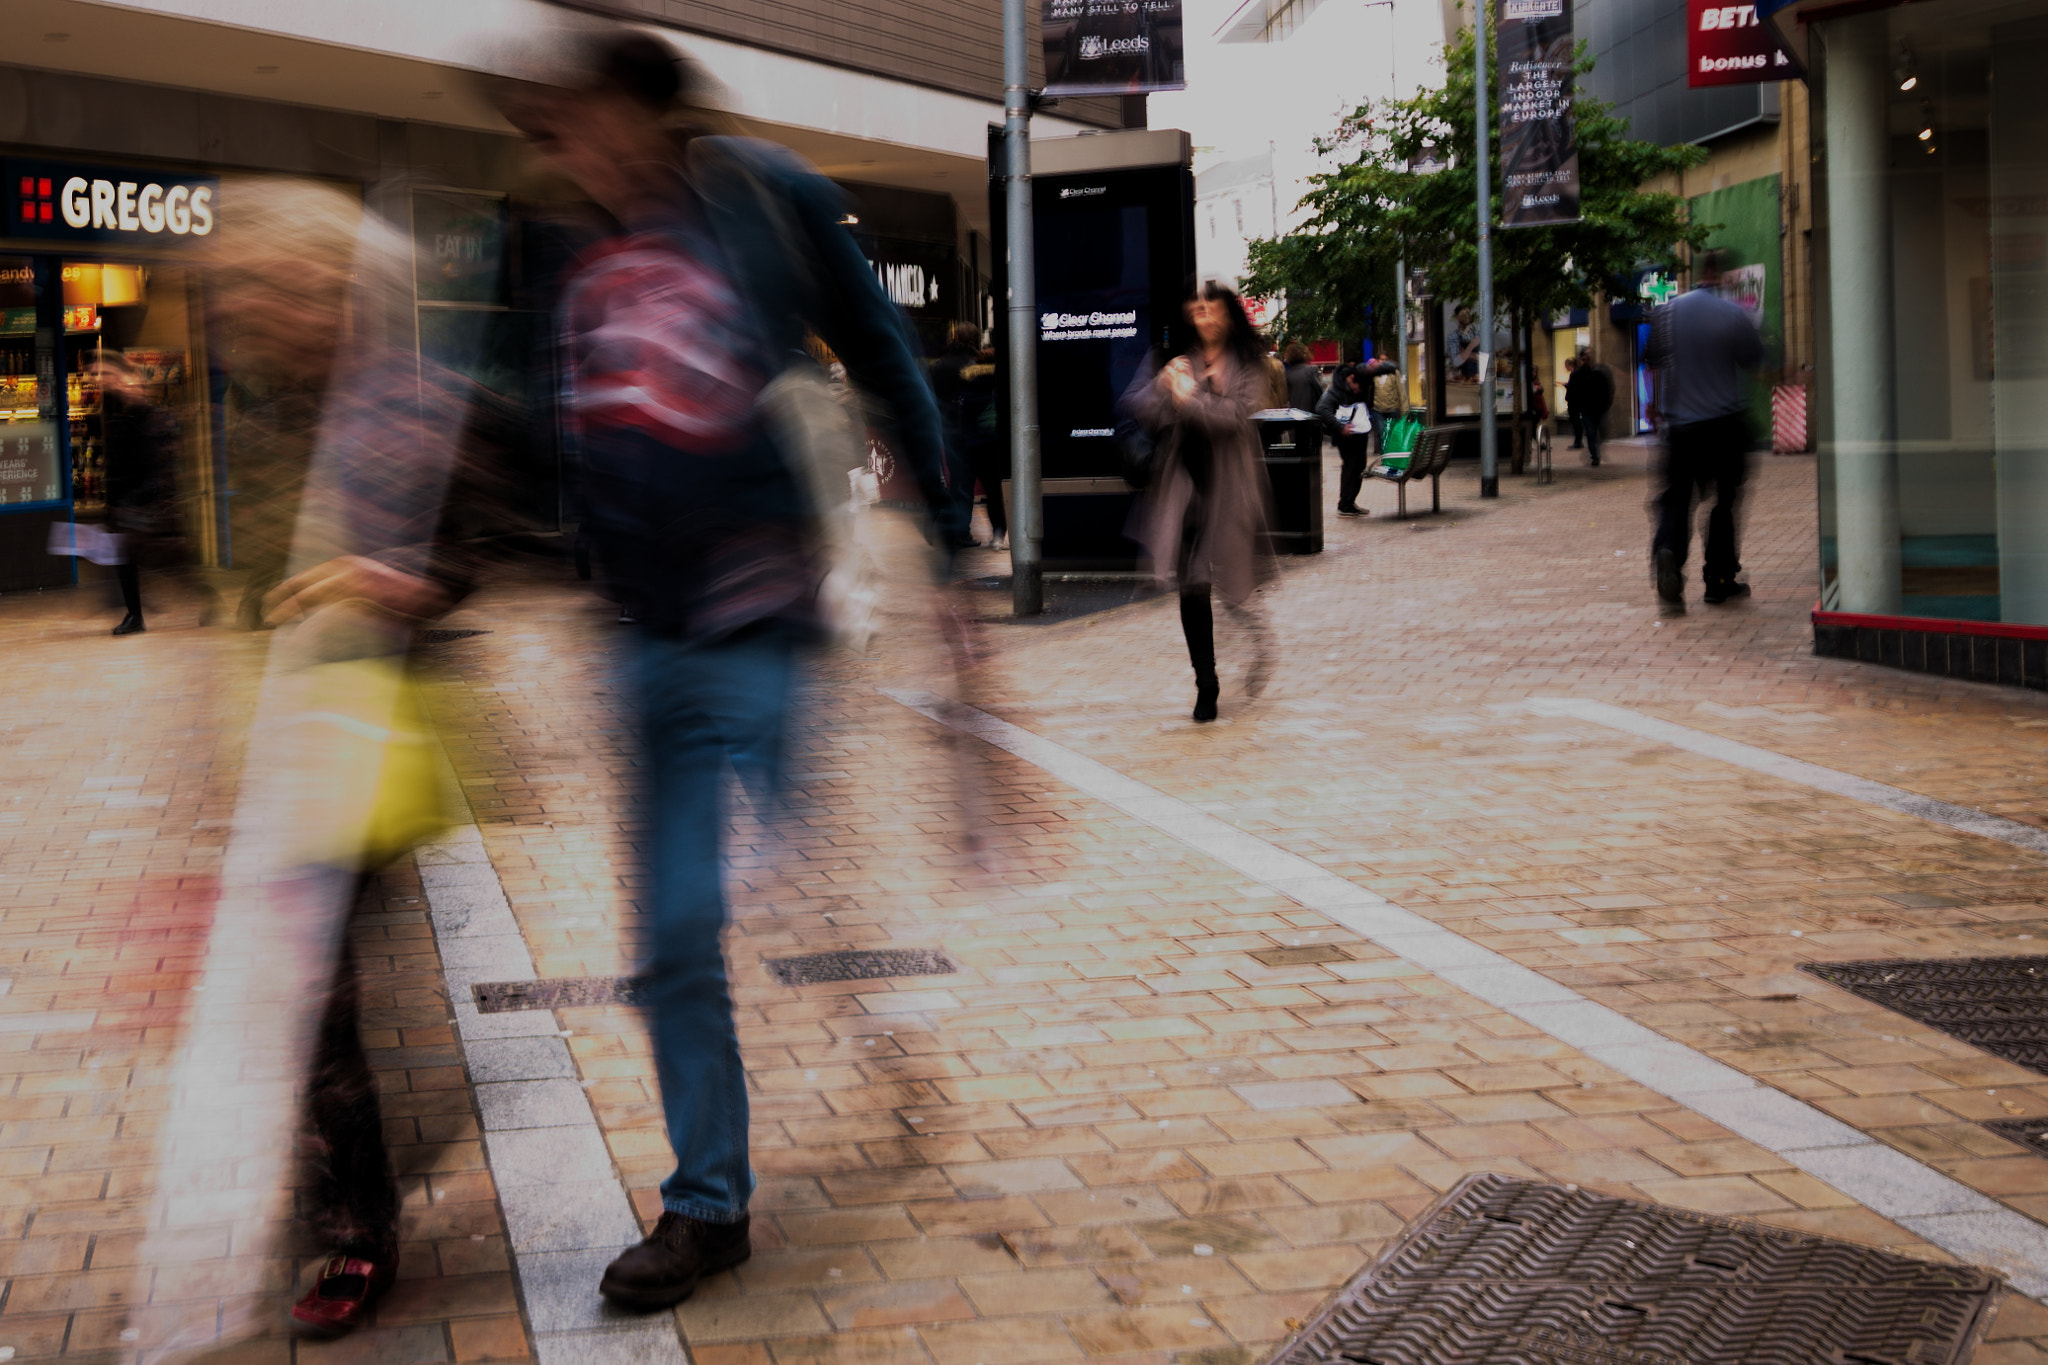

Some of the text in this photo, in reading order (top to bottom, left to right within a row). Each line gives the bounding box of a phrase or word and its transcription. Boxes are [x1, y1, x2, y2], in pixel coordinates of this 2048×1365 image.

[1051, 7, 1084, 19] MANY
[1087, 4, 1119, 16] STILL
[1122, 2, 1138, 13] TO
[1141, 1, 1174, 12] TELL.
[1103, 34, 1149, 52] Leeds
[1508, 60, 1562, 74] Rediscover
[1699, 54, 1767, 73] bonus
[1523, 70, 1548, 80] THE
[1507, 80, 1562, 93] LARGEST
[1511, 90, 1560, 102] INDOOR
[1501, 99, 1570, 112] MARKET IN
[1511, 108, 1562, 122] EUROPE
[61, 176, 213, 236] GREGGS
[1058, 310, 1136, 327] Clear Channel
